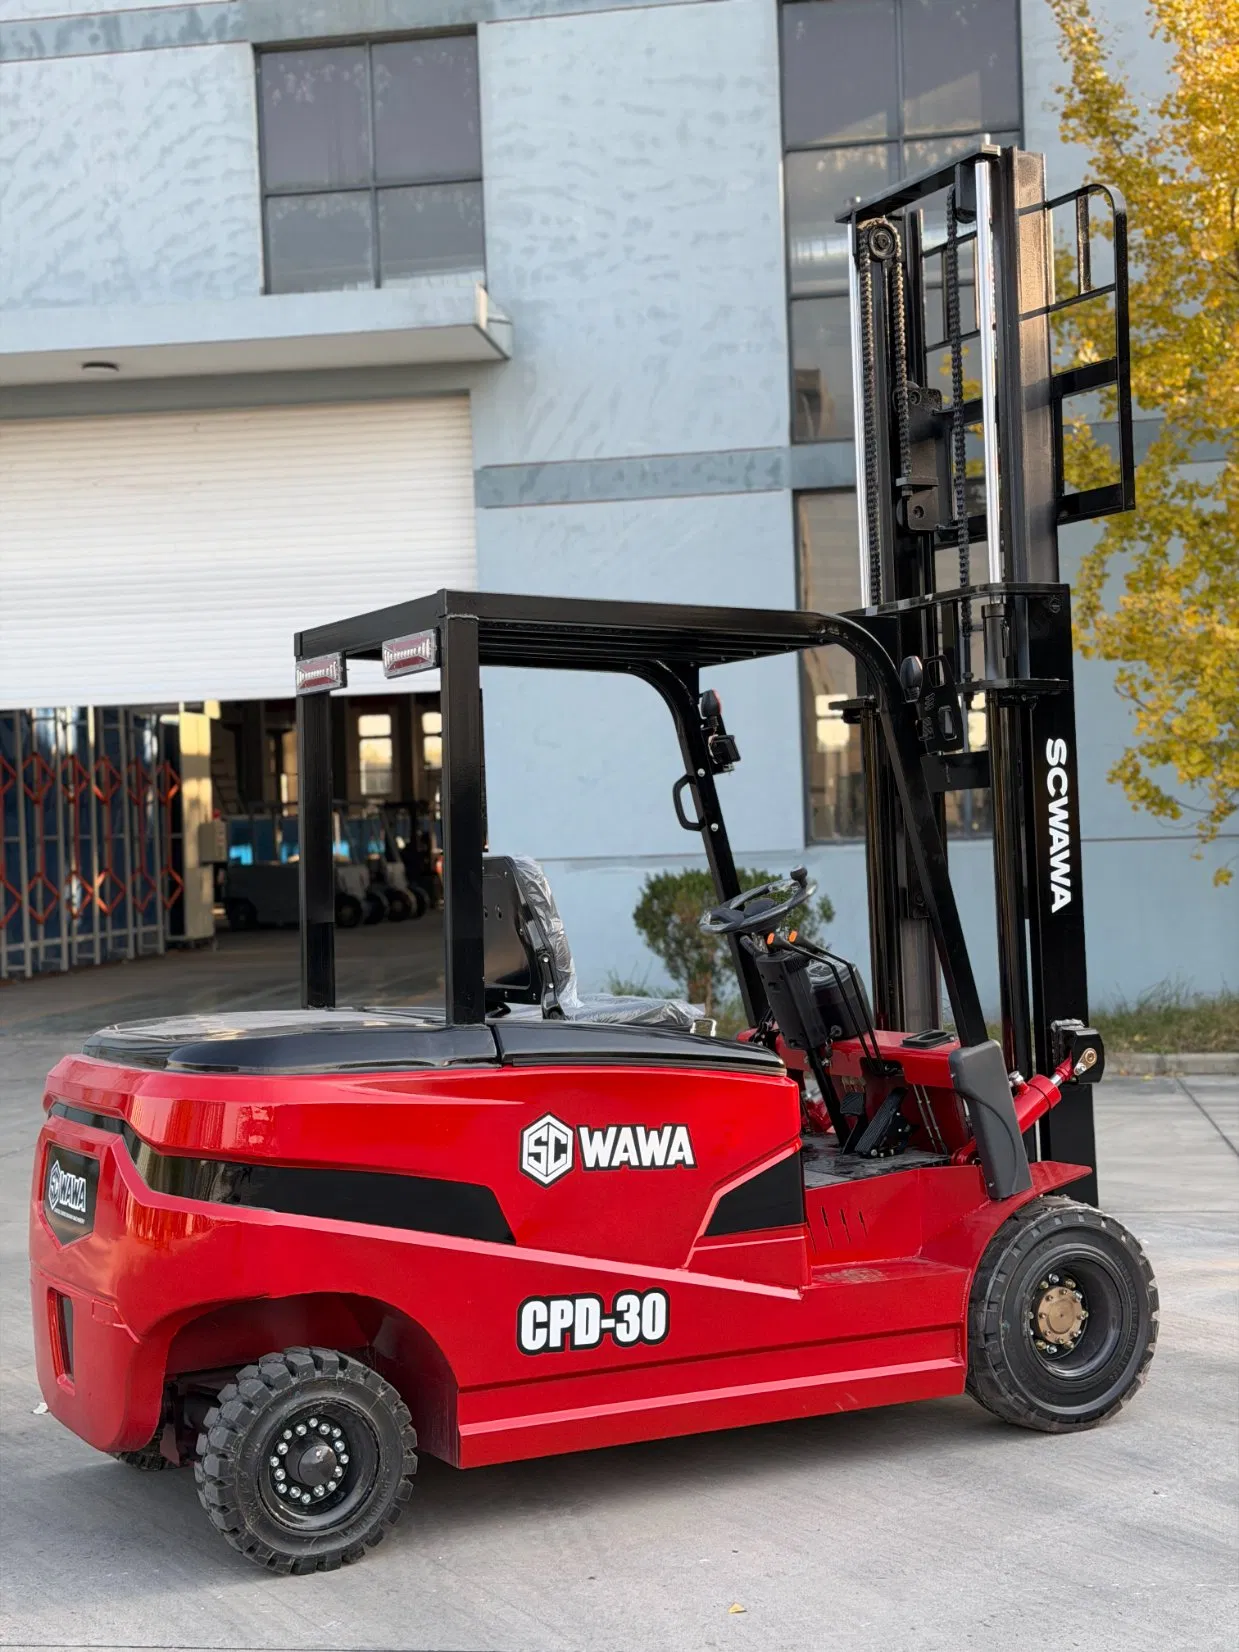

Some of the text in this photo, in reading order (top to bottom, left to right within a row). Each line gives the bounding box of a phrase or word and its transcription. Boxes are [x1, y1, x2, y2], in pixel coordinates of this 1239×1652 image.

[1045, 738, 1072, 914] SCWAWA
[579, 1125, 696, 1168] WAWA
[59, 1170, 87, 1213] WAWA
[520, 1291, 668, 1351] CPD-30
